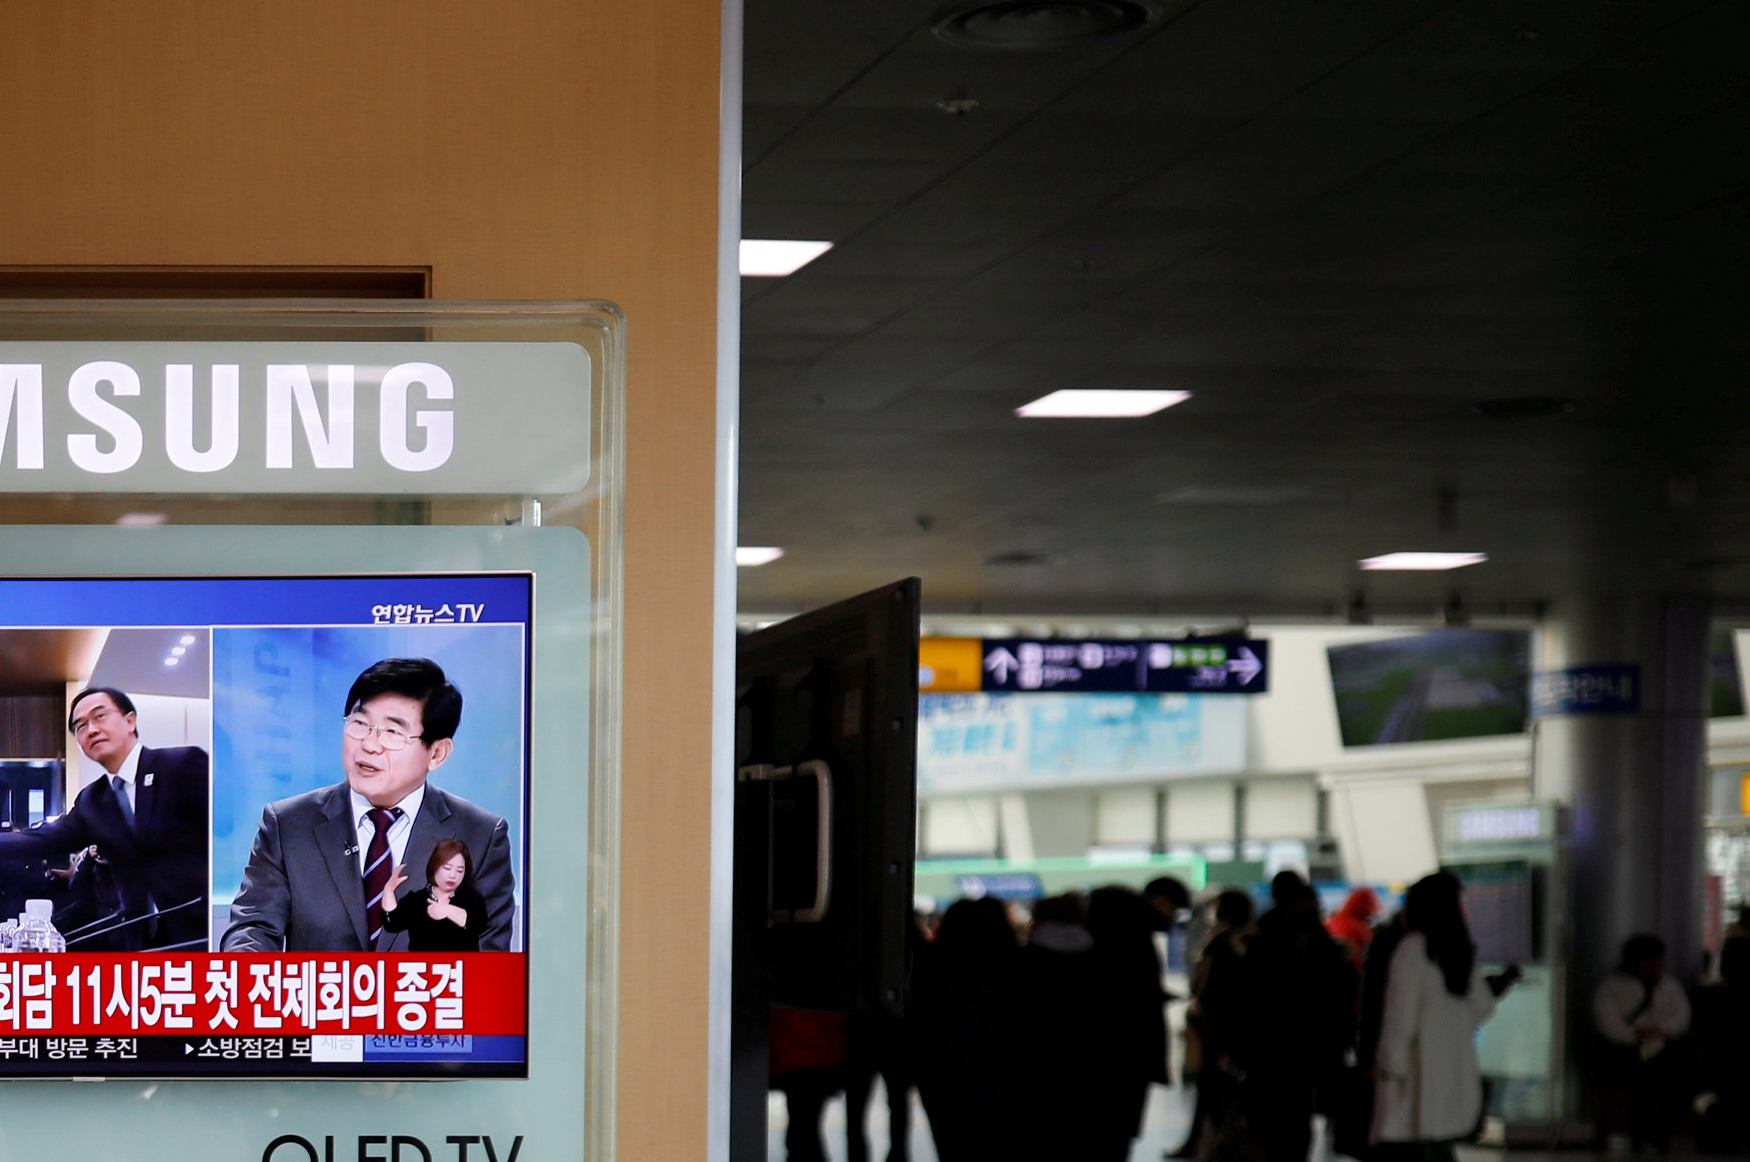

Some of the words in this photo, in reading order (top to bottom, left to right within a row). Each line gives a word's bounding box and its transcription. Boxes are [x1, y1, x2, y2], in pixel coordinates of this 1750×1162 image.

[371, 603, 485, 625] 연합뉴스TV
[66, 960, 197, 1030] 11시5분
[204, 960, 239, 1030] 첫
[248, 960, 385, 1030] 전체회의
[394, 960, 464, 1031] 종결
[46, 1038, 89, 1059] 방문
[94, 1038, 138, 1059] 추진
[198, 1038, 284, 1059] 소방점검
